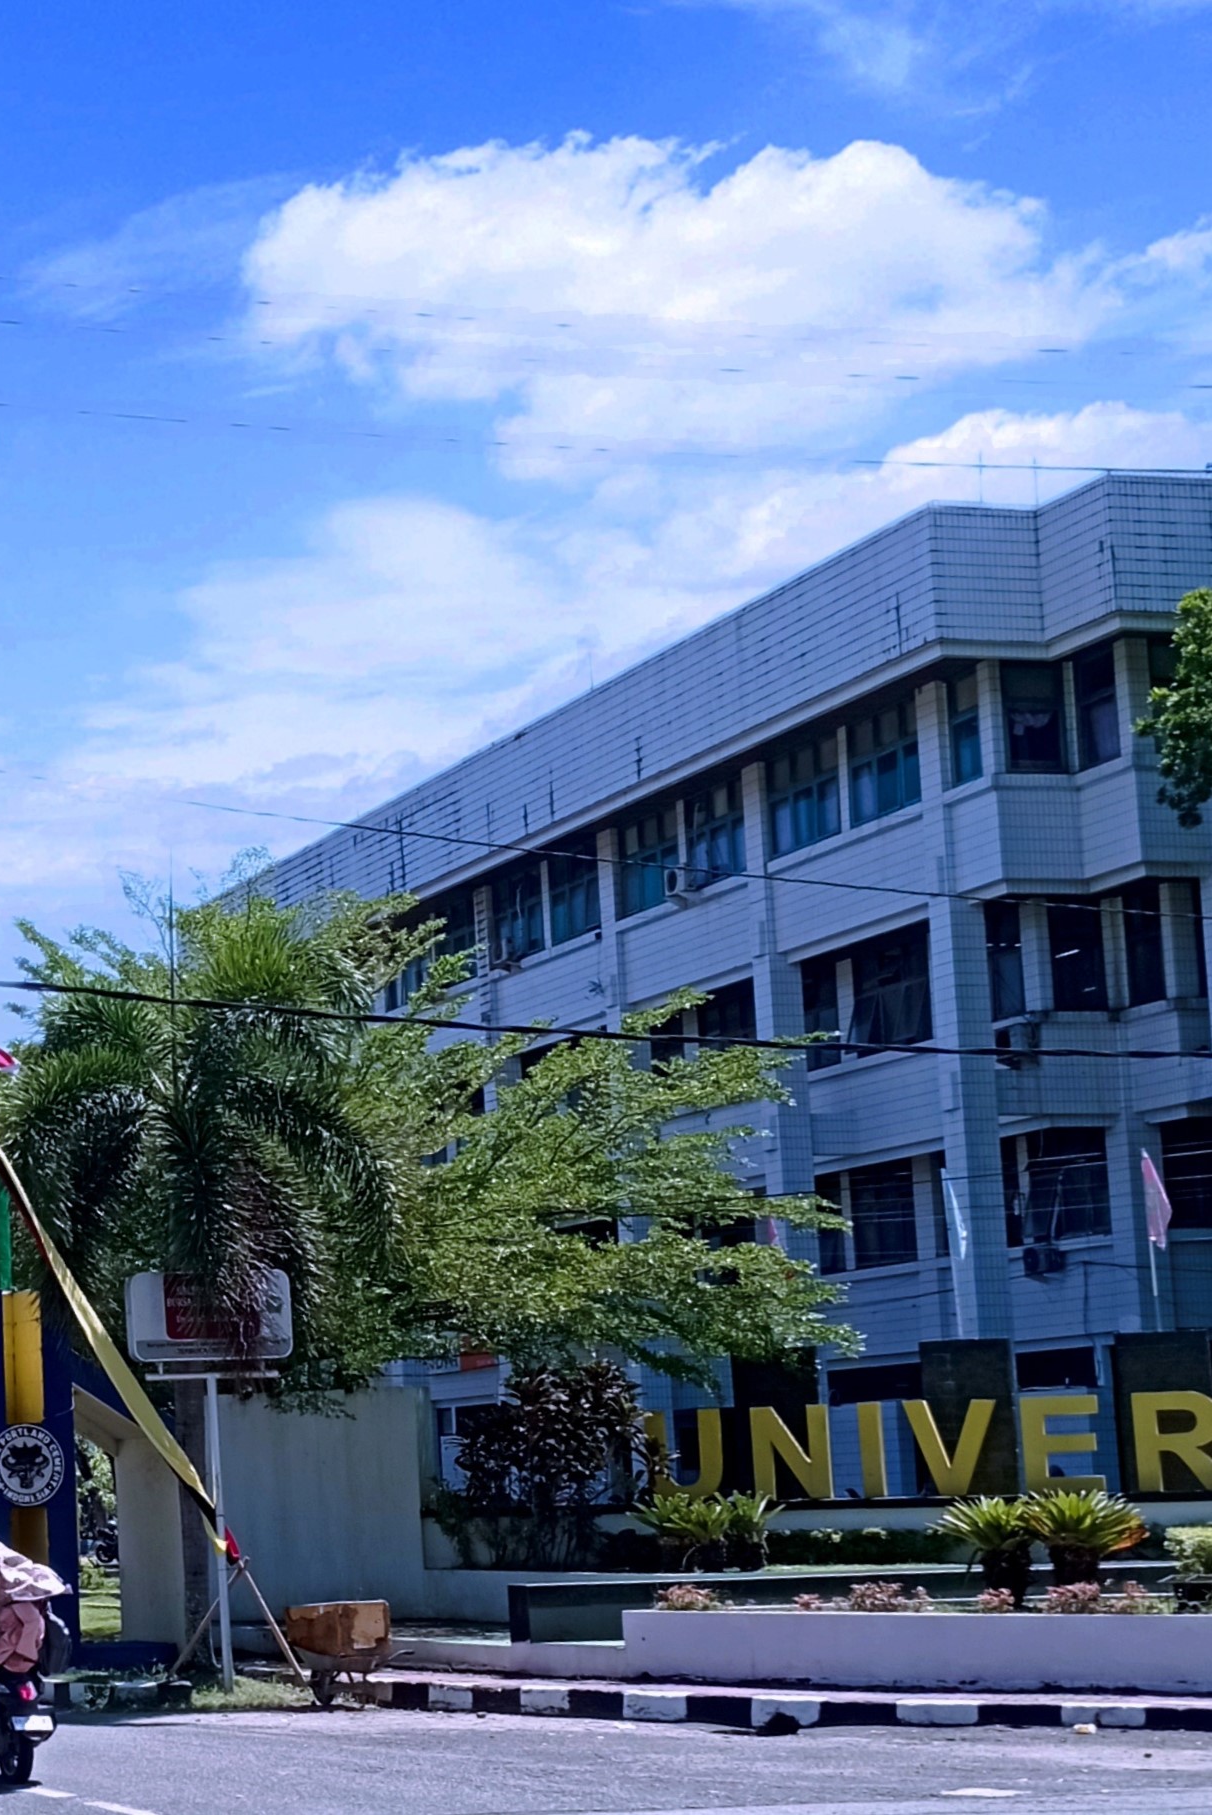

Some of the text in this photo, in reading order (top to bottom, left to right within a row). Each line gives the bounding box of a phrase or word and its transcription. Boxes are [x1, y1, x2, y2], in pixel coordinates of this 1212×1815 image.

[0, 1428, 51, 1445] PORTLAND
[49, 1444, 62, 1488] CEMENT
[644, 1390, 1212, 1499] UNIVER
